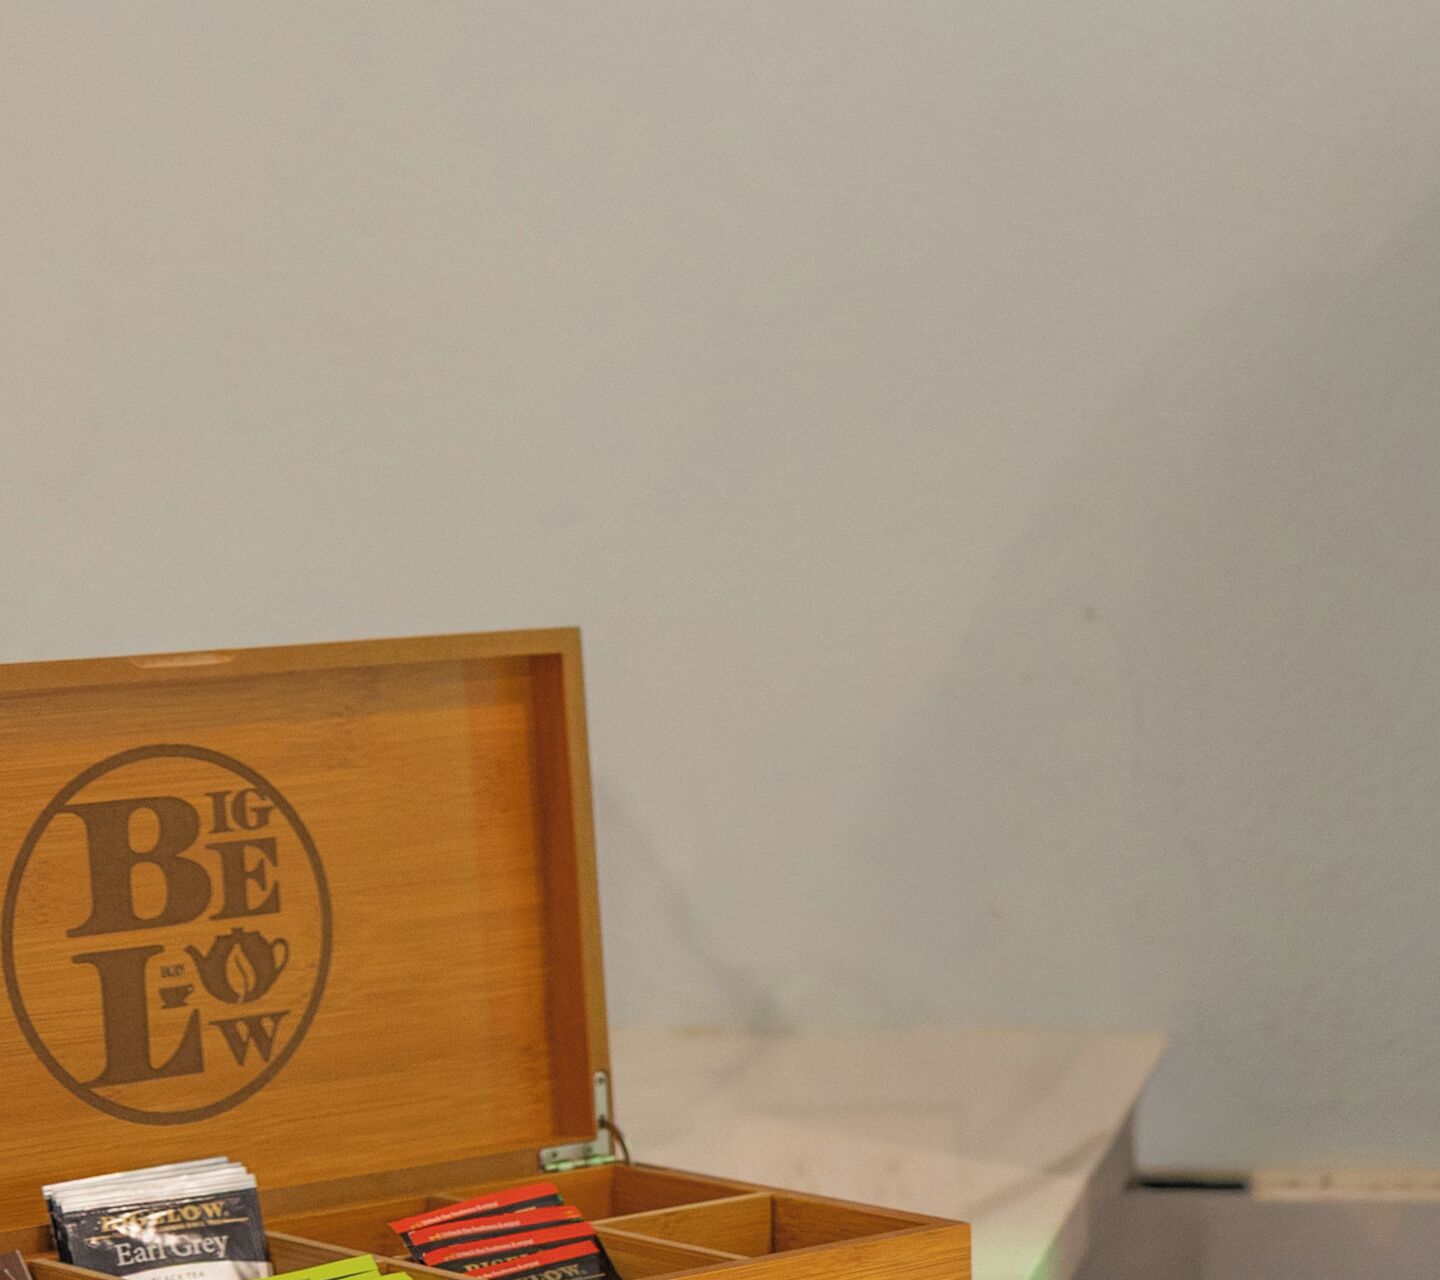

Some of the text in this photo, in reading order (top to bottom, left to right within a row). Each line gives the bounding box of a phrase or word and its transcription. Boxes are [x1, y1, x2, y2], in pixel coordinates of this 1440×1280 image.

[115, 1234, 229, 1267] Earl Grey
[185, 1270, 205, 1280] TEA
